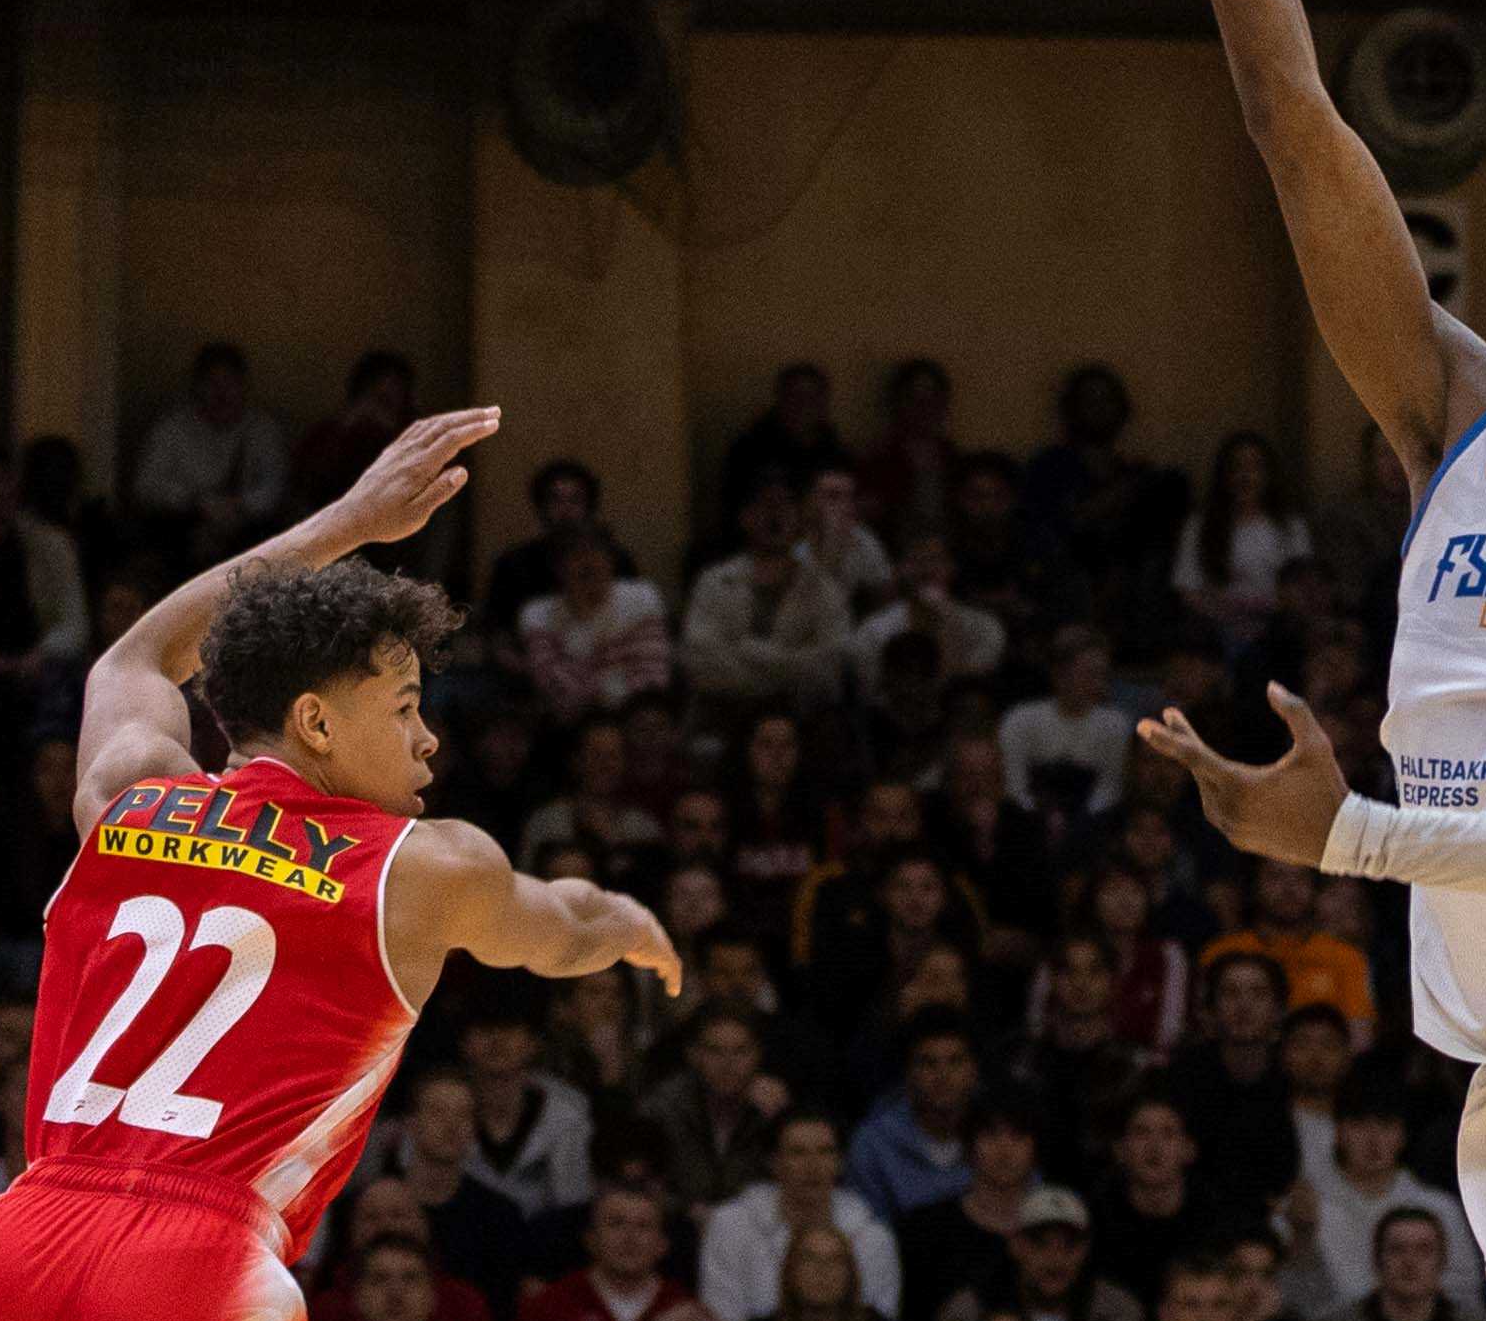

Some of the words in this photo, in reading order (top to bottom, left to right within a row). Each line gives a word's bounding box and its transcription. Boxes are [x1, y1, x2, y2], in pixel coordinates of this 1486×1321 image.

[101, 784, 363, 875] PELLY
[1403, 782, 1480, 808] EXPRESS
[103, 827, 340, 901] WORKWEAR
[42, 894, 277, 1139] 22
